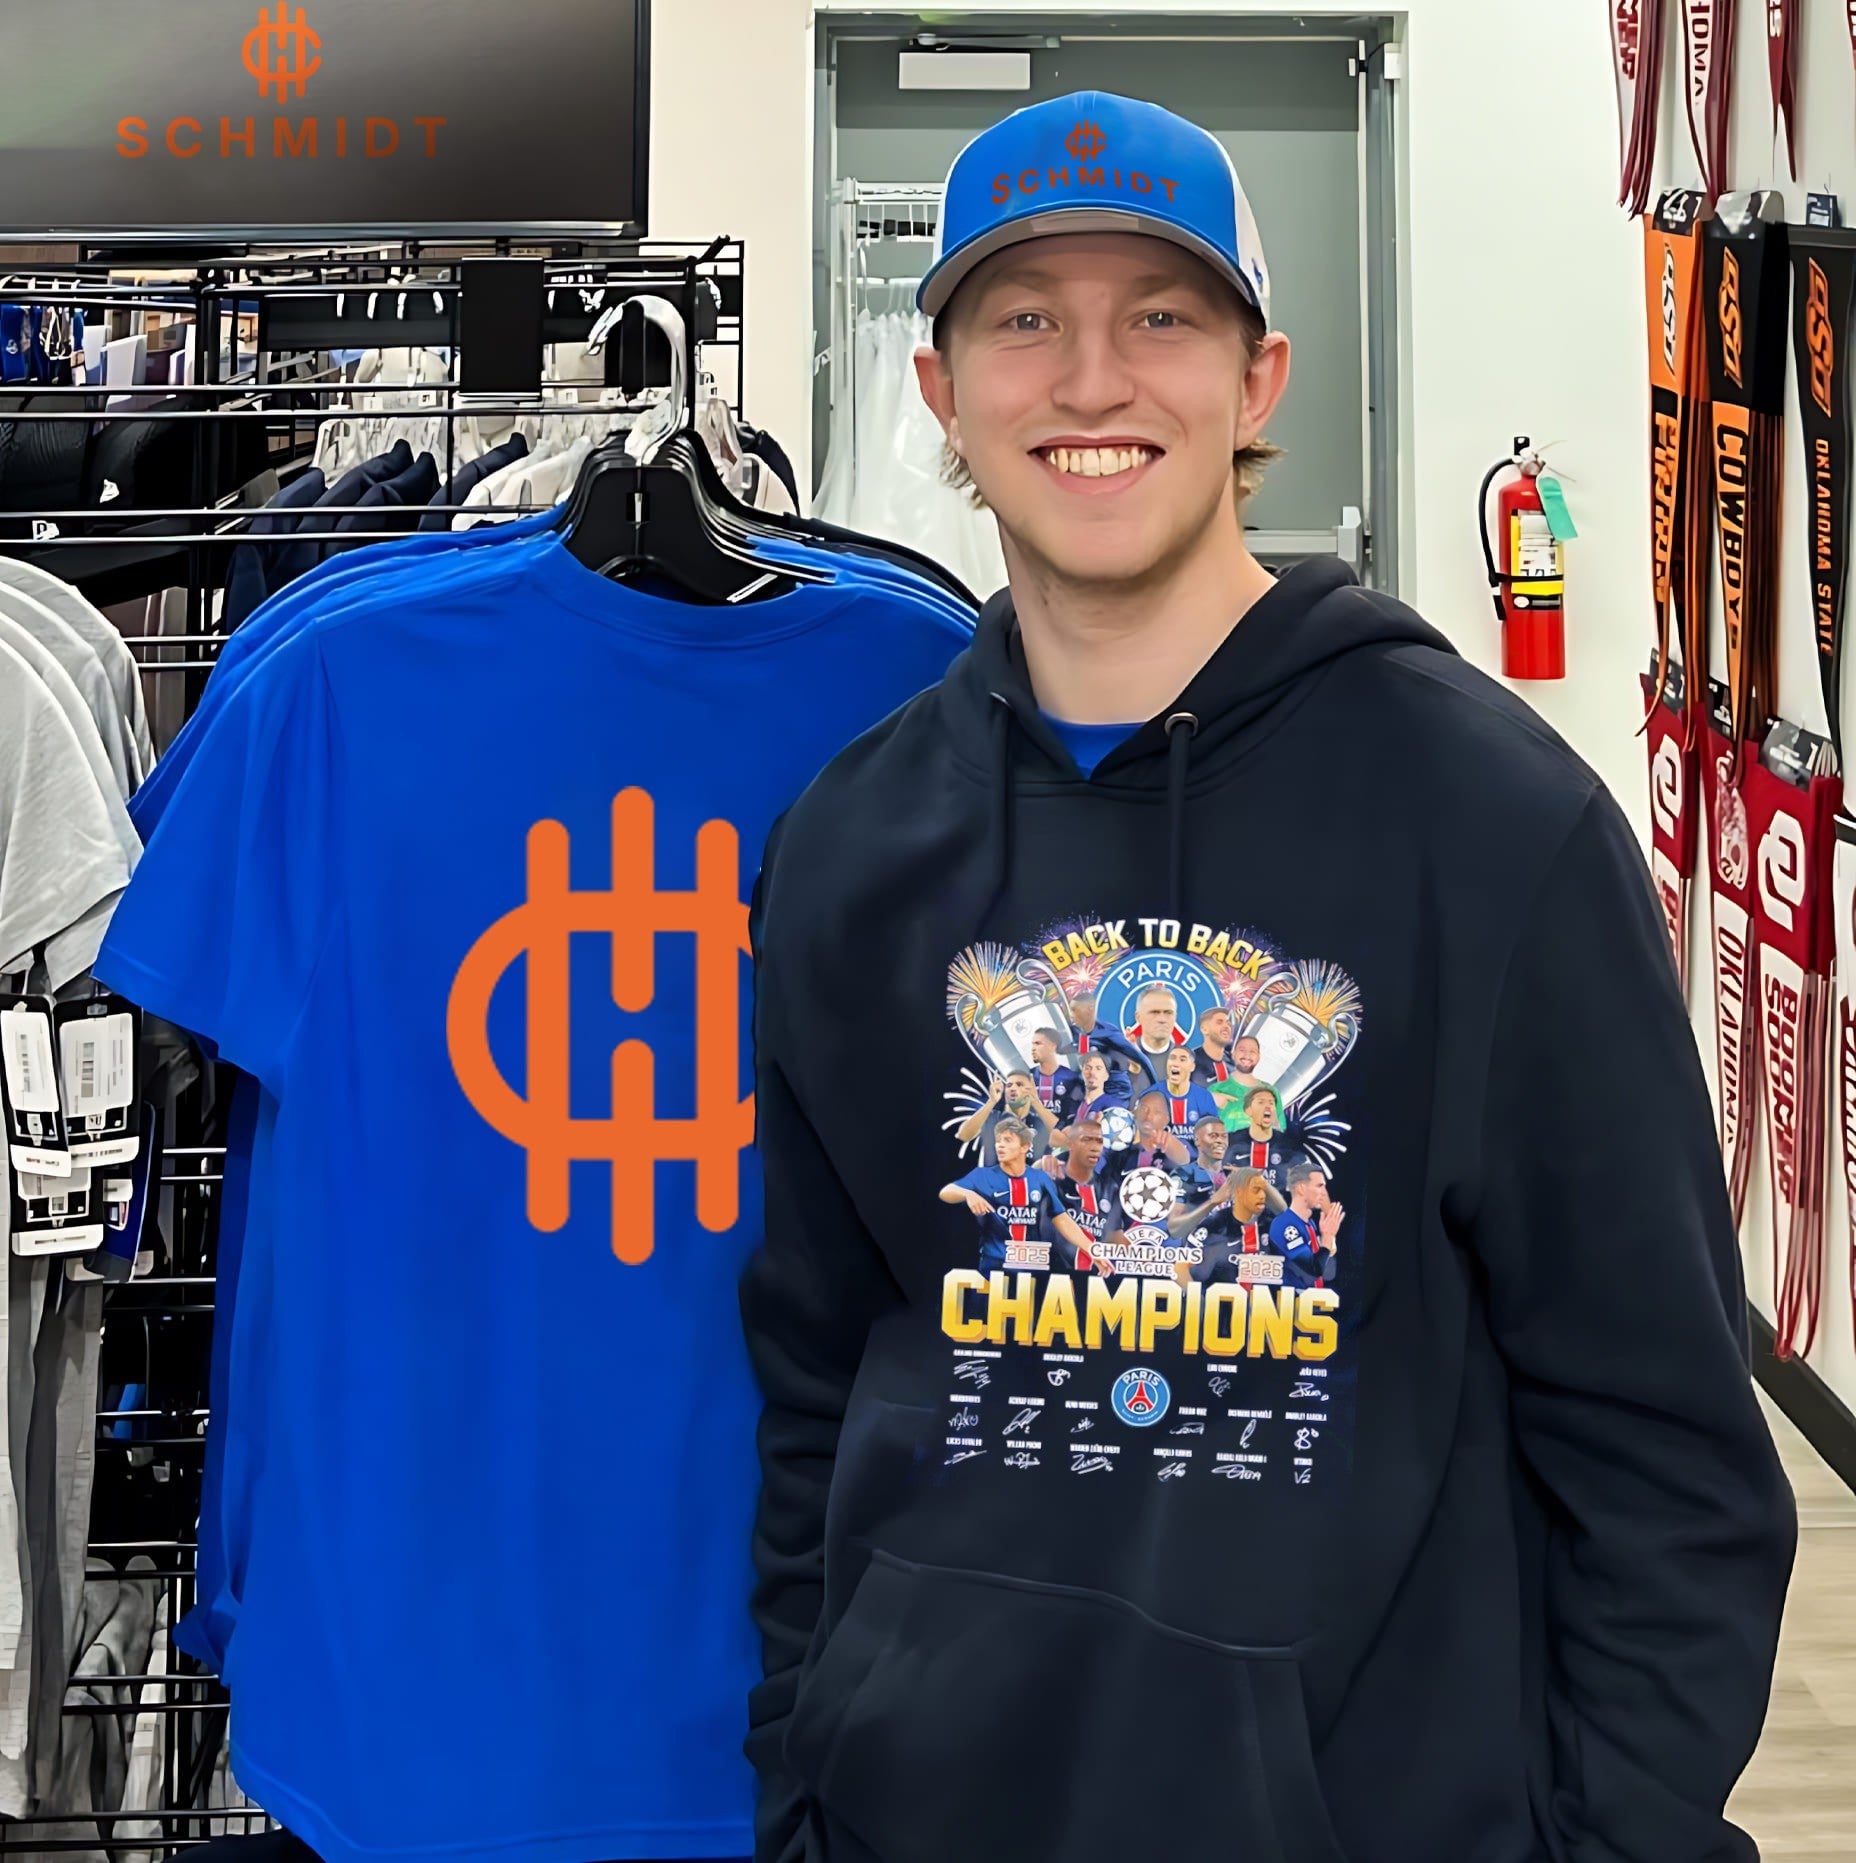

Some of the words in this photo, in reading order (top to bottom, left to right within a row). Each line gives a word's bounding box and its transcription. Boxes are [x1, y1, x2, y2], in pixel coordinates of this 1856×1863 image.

[115, 116, 448, 158] SCHMIDT
[991, 167, 1179, 204] SCHMIDT
[1042, 919, 1130, 971] BACK
[1138, 917, 1181, 949] TO
[1187, 923, 1274, 981] BACK
[1117, 960, 1202, 992] PARIS
[996, 1205, 1038, 1220] QATAR
[1066, 1208, 1107, 1229] QATAR
[1128, 1229, 1163, 1245] UEFA
[1007, 1247, 1048, 1263] 2025
[1091, 1243, 1202, 1262] CHAMPIONS
[1117, 1262, 1173, 1275] LEAGUE
[1240, 1260, 1282, 1277] 2026
[941, 1268, 1340, 1361] CHAMPIONS
[1122, 1370, 1161, 1387] PARIS
